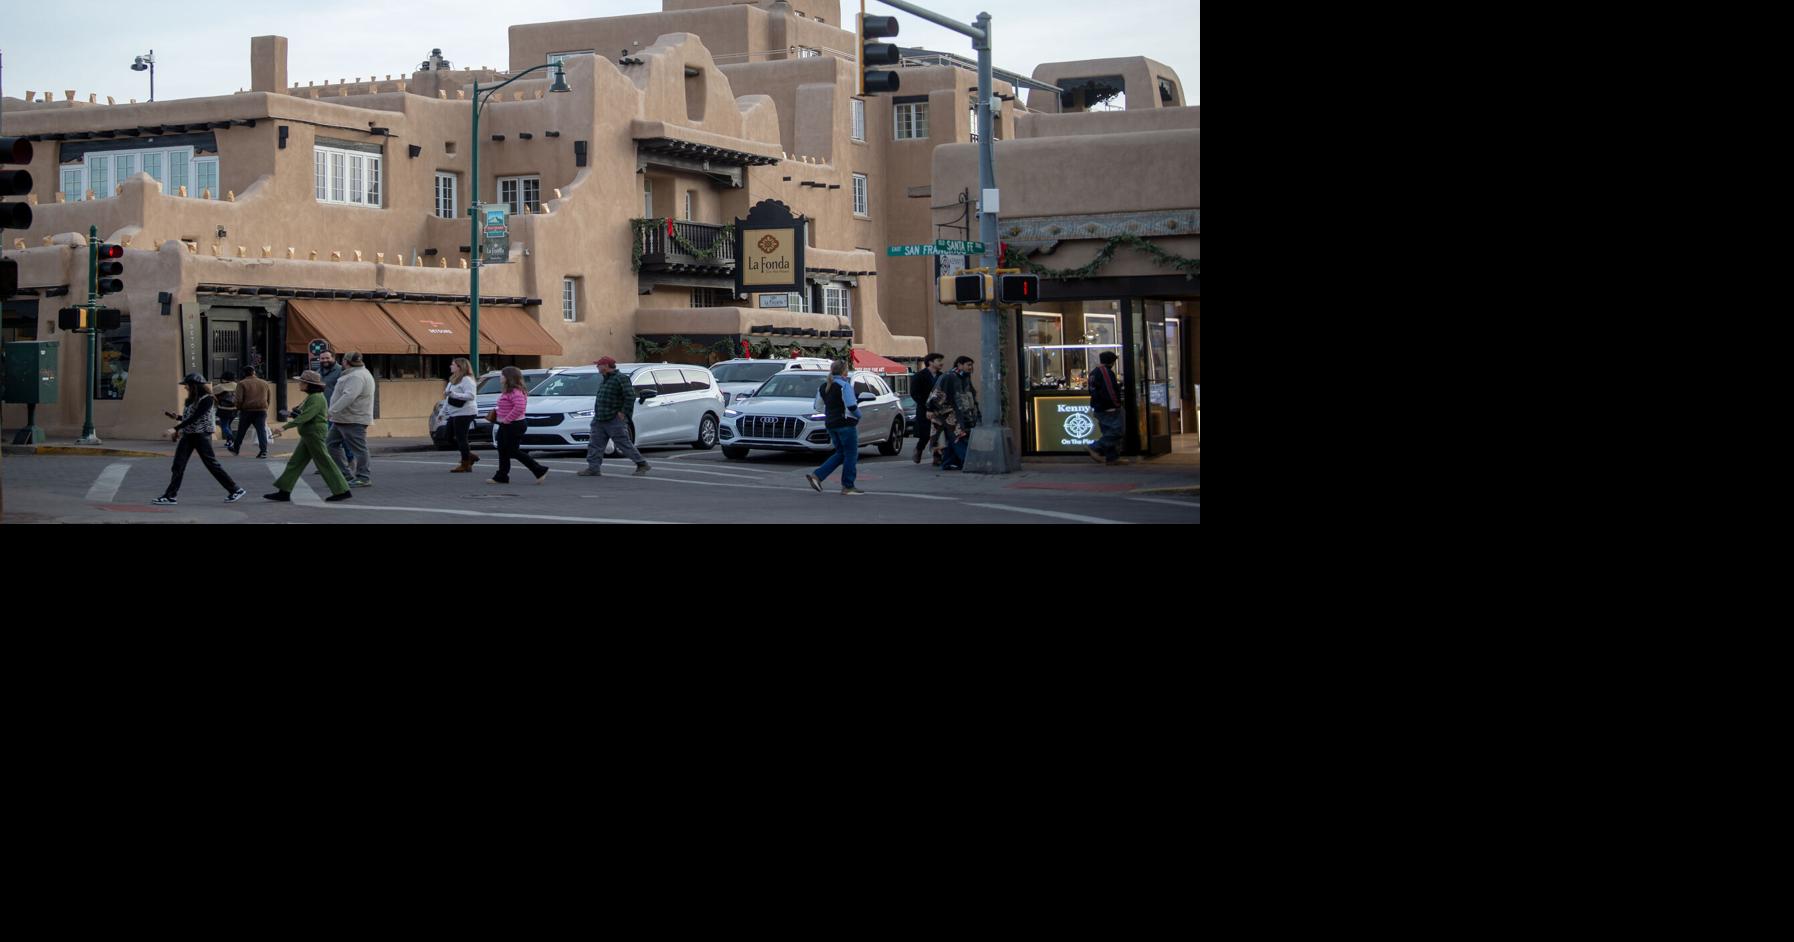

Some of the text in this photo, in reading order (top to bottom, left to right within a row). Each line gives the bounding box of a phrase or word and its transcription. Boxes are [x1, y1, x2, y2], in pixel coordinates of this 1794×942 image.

[904, 246, 920, 256] SAN
[946, 241, 965, 251] SANTA
[967, 242, 974, 252] FE
[748, 256, 790, 273] La Fonda
